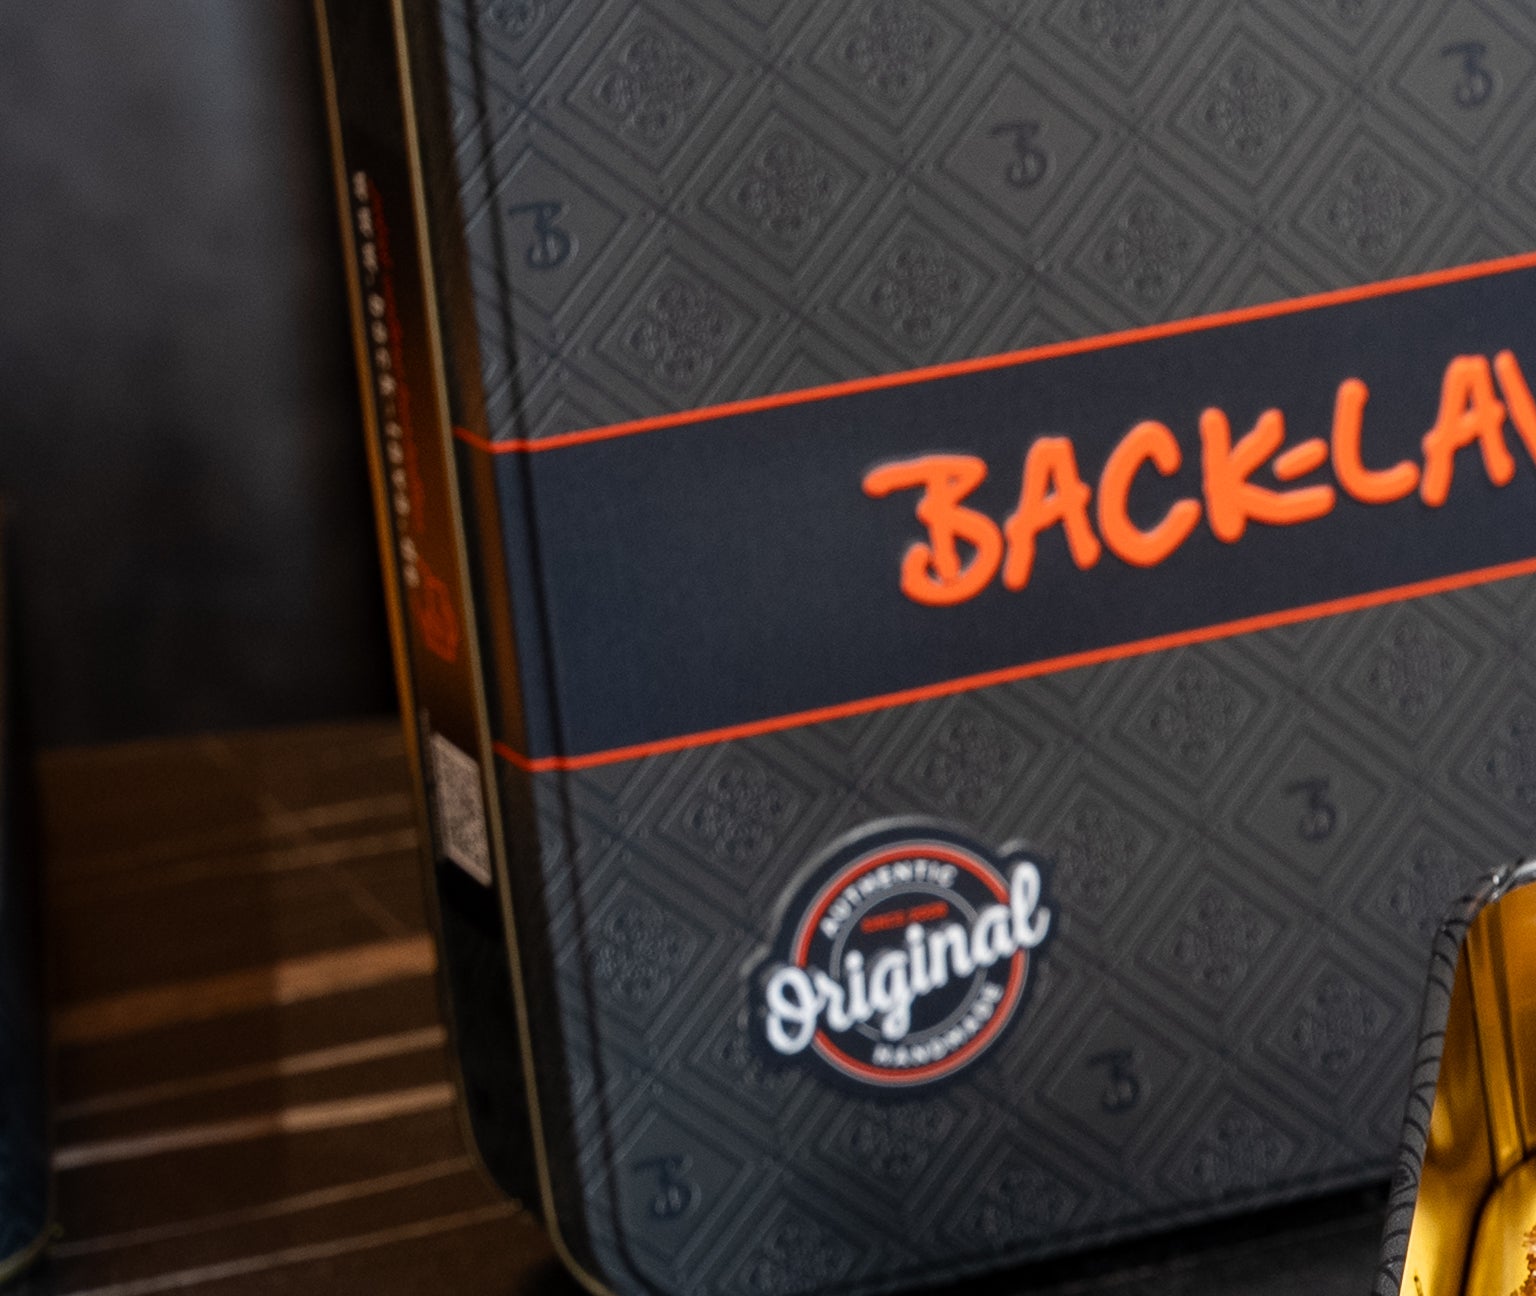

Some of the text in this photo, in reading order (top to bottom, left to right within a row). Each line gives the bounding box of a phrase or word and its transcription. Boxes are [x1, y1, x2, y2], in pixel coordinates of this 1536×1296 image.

[819, 858, 959, 940] AUTHENTIC
[765, 860, 1051, 1056] Original
[872, 982, 1004, 1069] HANDMADE
